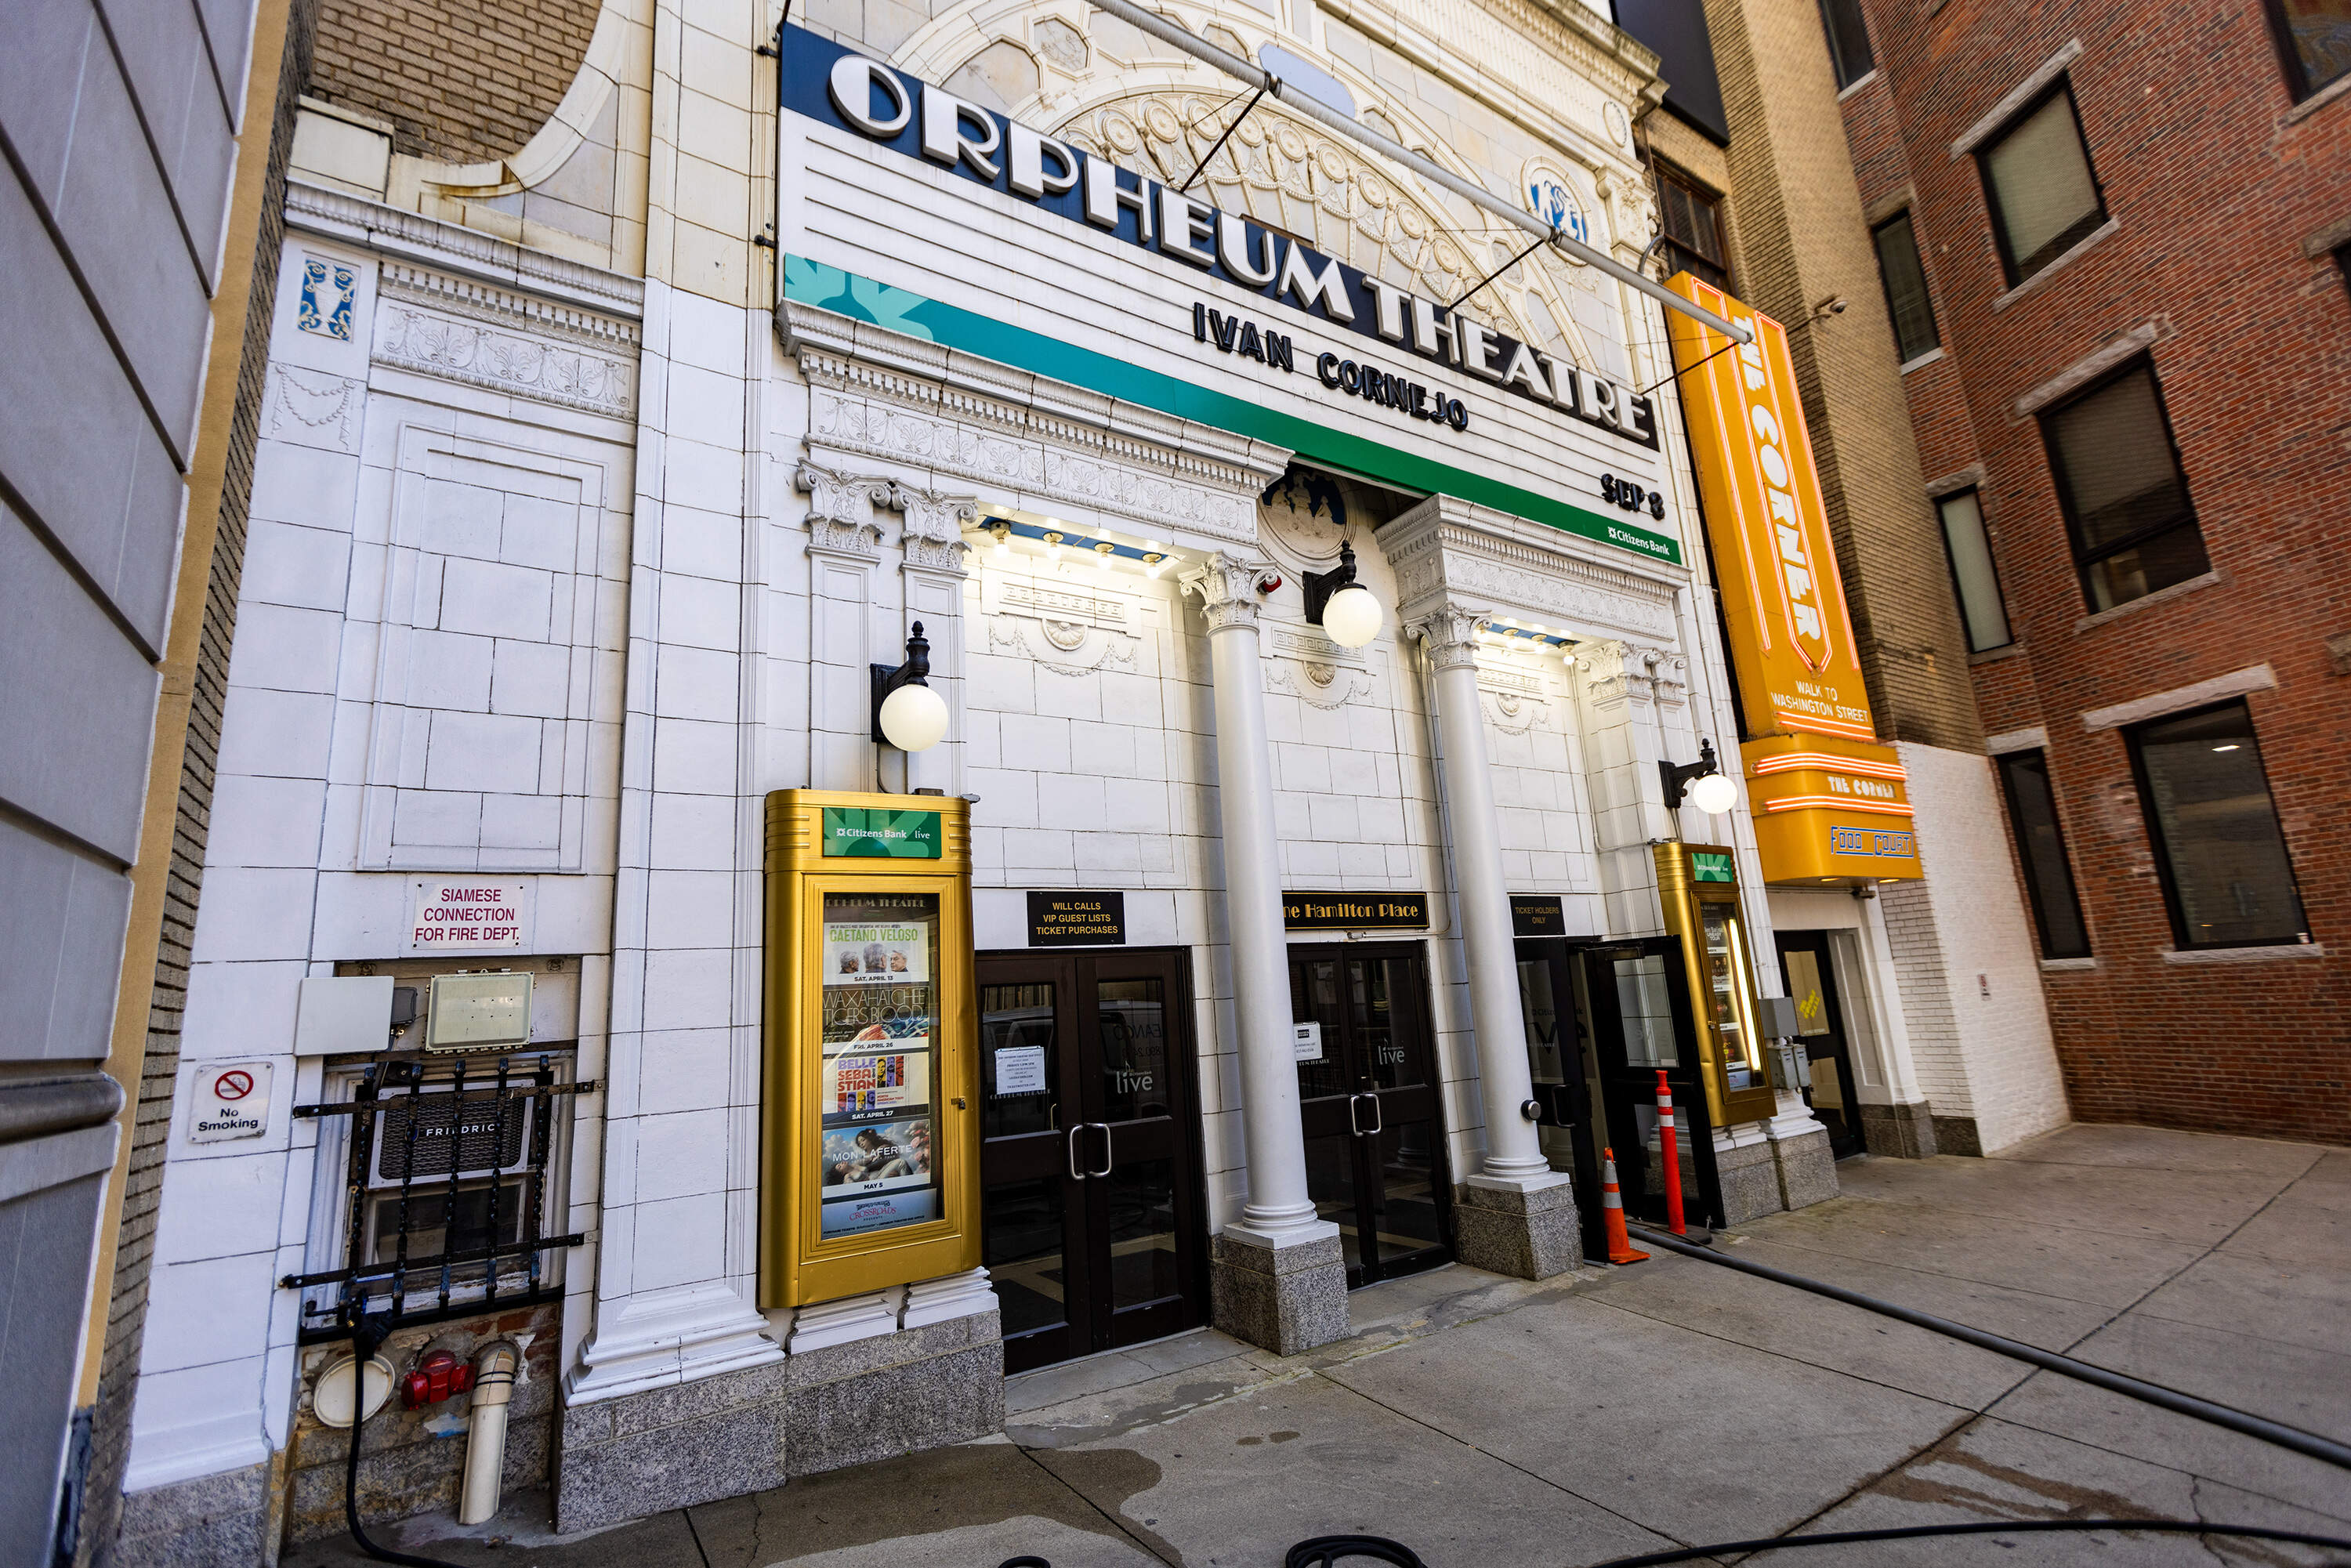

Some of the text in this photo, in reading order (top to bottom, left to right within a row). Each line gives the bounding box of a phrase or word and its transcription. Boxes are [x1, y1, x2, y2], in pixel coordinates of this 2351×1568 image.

[829, 54, 1650, 441] ORPHEUM THEATRE
[1193, 302, 1469, 432] IVAN CORNEJO
[1600, 473, 1665, 522] SEP 8
[1751, 404, 1822, 641] CORNER
[1617, 530, 1670, 556] Citizens Bank
[1796, 680, 1838, 701] WALK TO
[1771, 691, 1868, 722] WASHINGTON STREET
[1828, 776, 1850, 793] THE
[846, 827, 930, 839] Citizens Bank live
[1831, 826, 1911, 856] FOOD COURT
[441, 889, 502, 902] SIAMESE
[1052, 902, 1101, 911] WILL CALLS
[1305, 904, 1375, 918] Hamilton
[1378, 903, 1418, 918] Place
[424, 907, 515, 922] CONNECTION
[1059, 914, 1086, 922] GUEST
[1089, 914, 1111, 922] LISTS
[415, 927, 520, 941] FOR FIRE DEPT.
[830, 928, 918, 943] CAETANO VELOSO
[1036, 925, 1118, 935] TICKET PURCHASES
[822, 987, 926, 1009] WAXAHATCHEE
[823, 1005, 924, 1026] TIGERS BLOOD
[1378, 1045, 1405, 1065] live
[839, 1058, 876, 1070] BELLE
[838, 1069, 871, 1081] SEBA
[1117, 1070, 1153, 1094] live
[837, 1078, 876, 1092] STIAN
[220, 1107, 239, 1117] No
[198, 1118, 259, 1132] Smoking
[832, 1145, 913, 1162] MON LAFERTE
[849, 1207, 897, 1222] CROSSROADS
